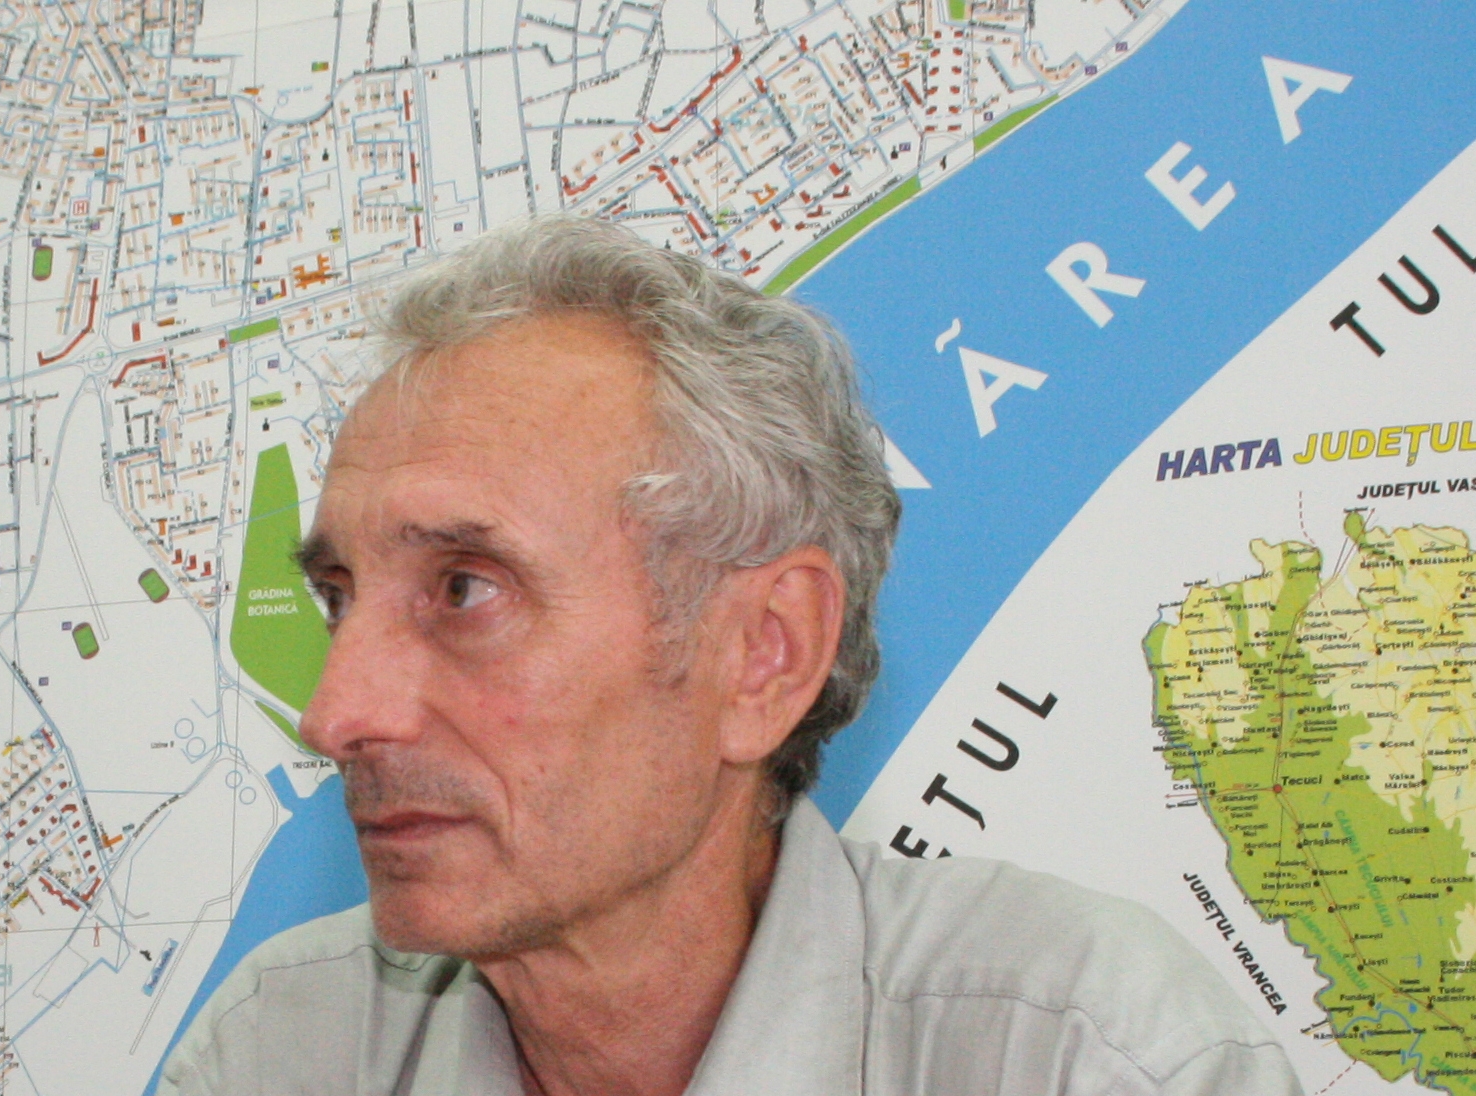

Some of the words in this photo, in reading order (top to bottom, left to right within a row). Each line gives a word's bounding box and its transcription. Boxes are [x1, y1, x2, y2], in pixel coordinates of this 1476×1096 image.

[1156, 437, 1283, 482] HARTA
[1281, 775, 1322, 787] Tecuci
[1233, 941, 1287, 1016] VRANCEA
